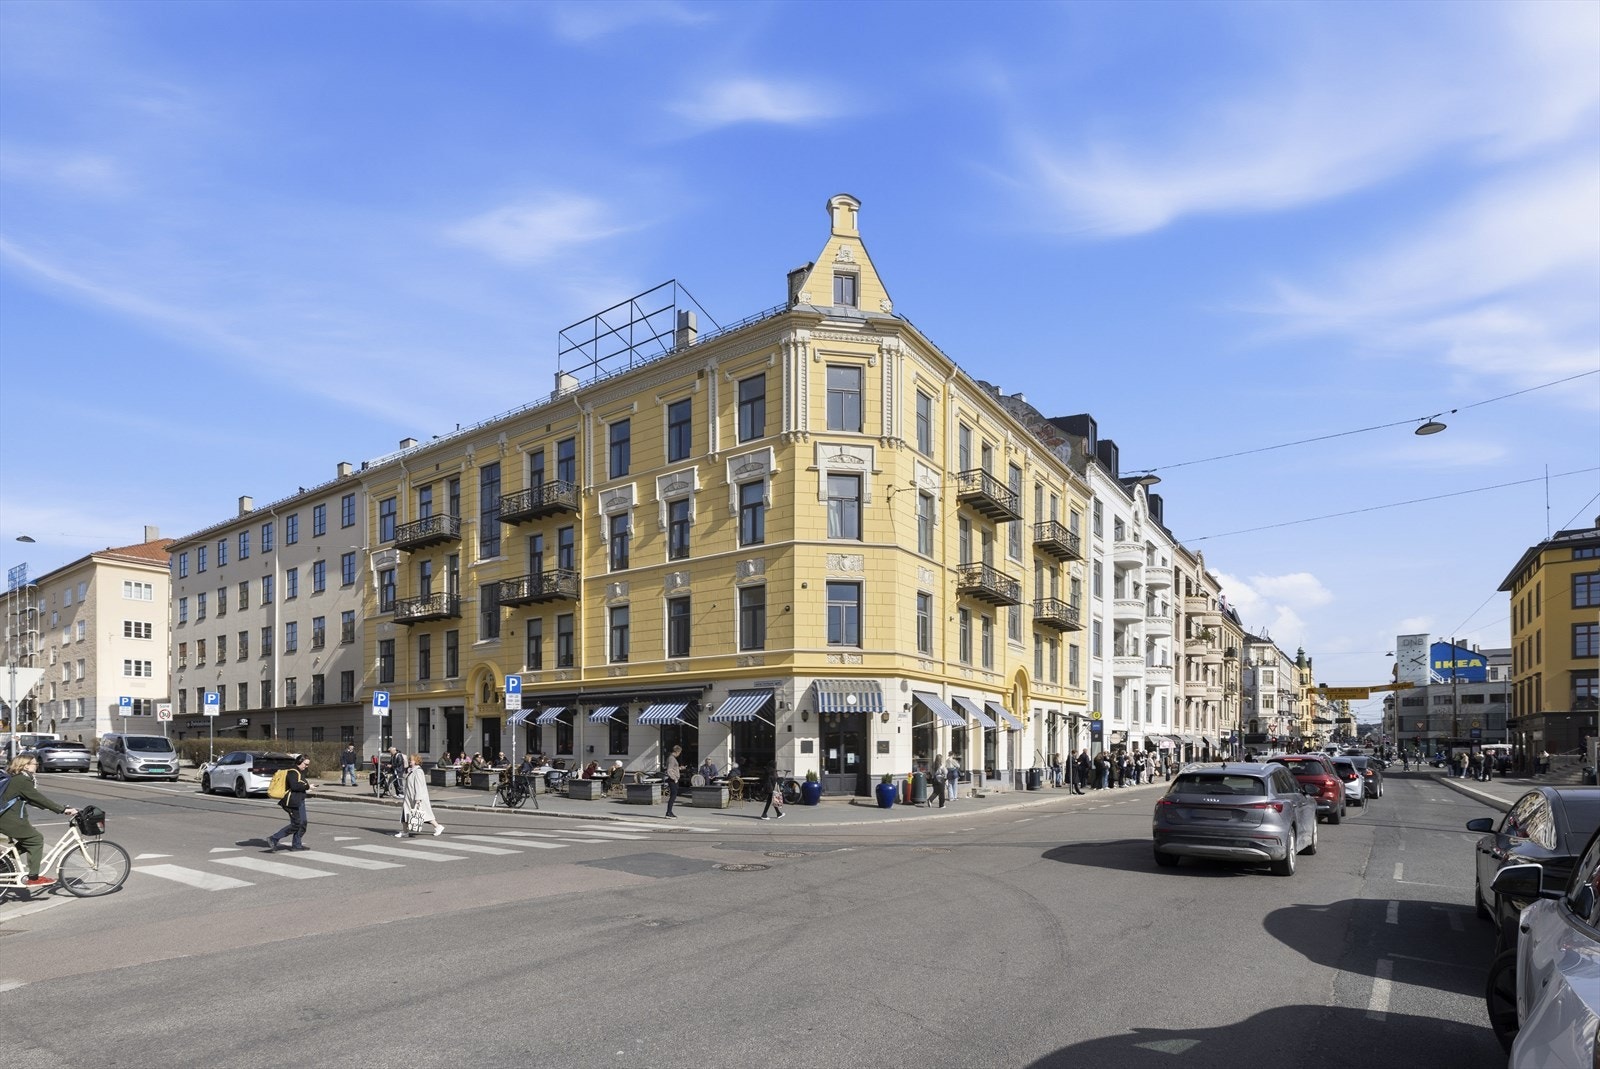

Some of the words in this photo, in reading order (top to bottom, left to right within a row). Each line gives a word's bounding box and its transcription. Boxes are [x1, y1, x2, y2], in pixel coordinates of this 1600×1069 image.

[1403, 638, 1424, 646] DNB
[1435, 659, 1482, 669] IKEA
[509, 678, 518, 691] P
[122, 697, 129, 706] P
[208, 694, 216, 703] P
[377, 694, 386, 705] P
